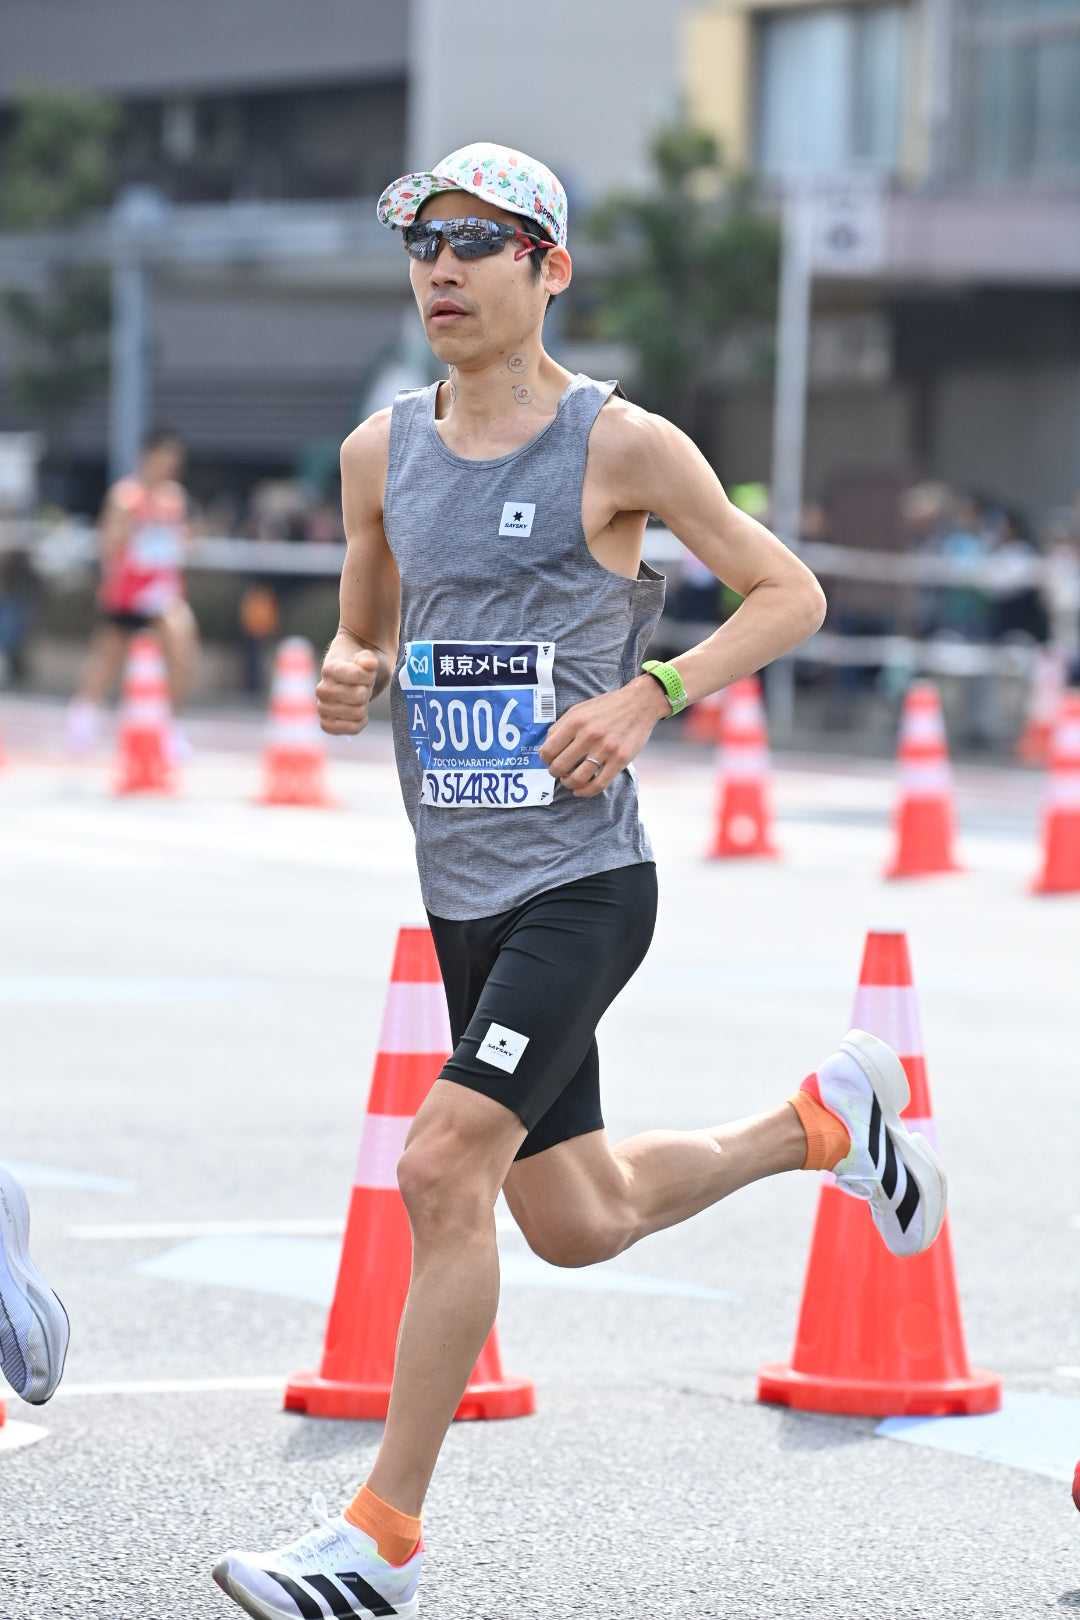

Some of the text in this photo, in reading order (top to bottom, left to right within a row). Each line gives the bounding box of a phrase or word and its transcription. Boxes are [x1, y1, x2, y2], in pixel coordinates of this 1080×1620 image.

[439, 654, 528, 676] 東京メトロ
[412, 704, 426, 731] A
[429, 698, 521, 751] 3006
[433, 756, 530, 767] TOKYO MARATHON 2025
[487, 1043, 514, 1057] SAYSKY
